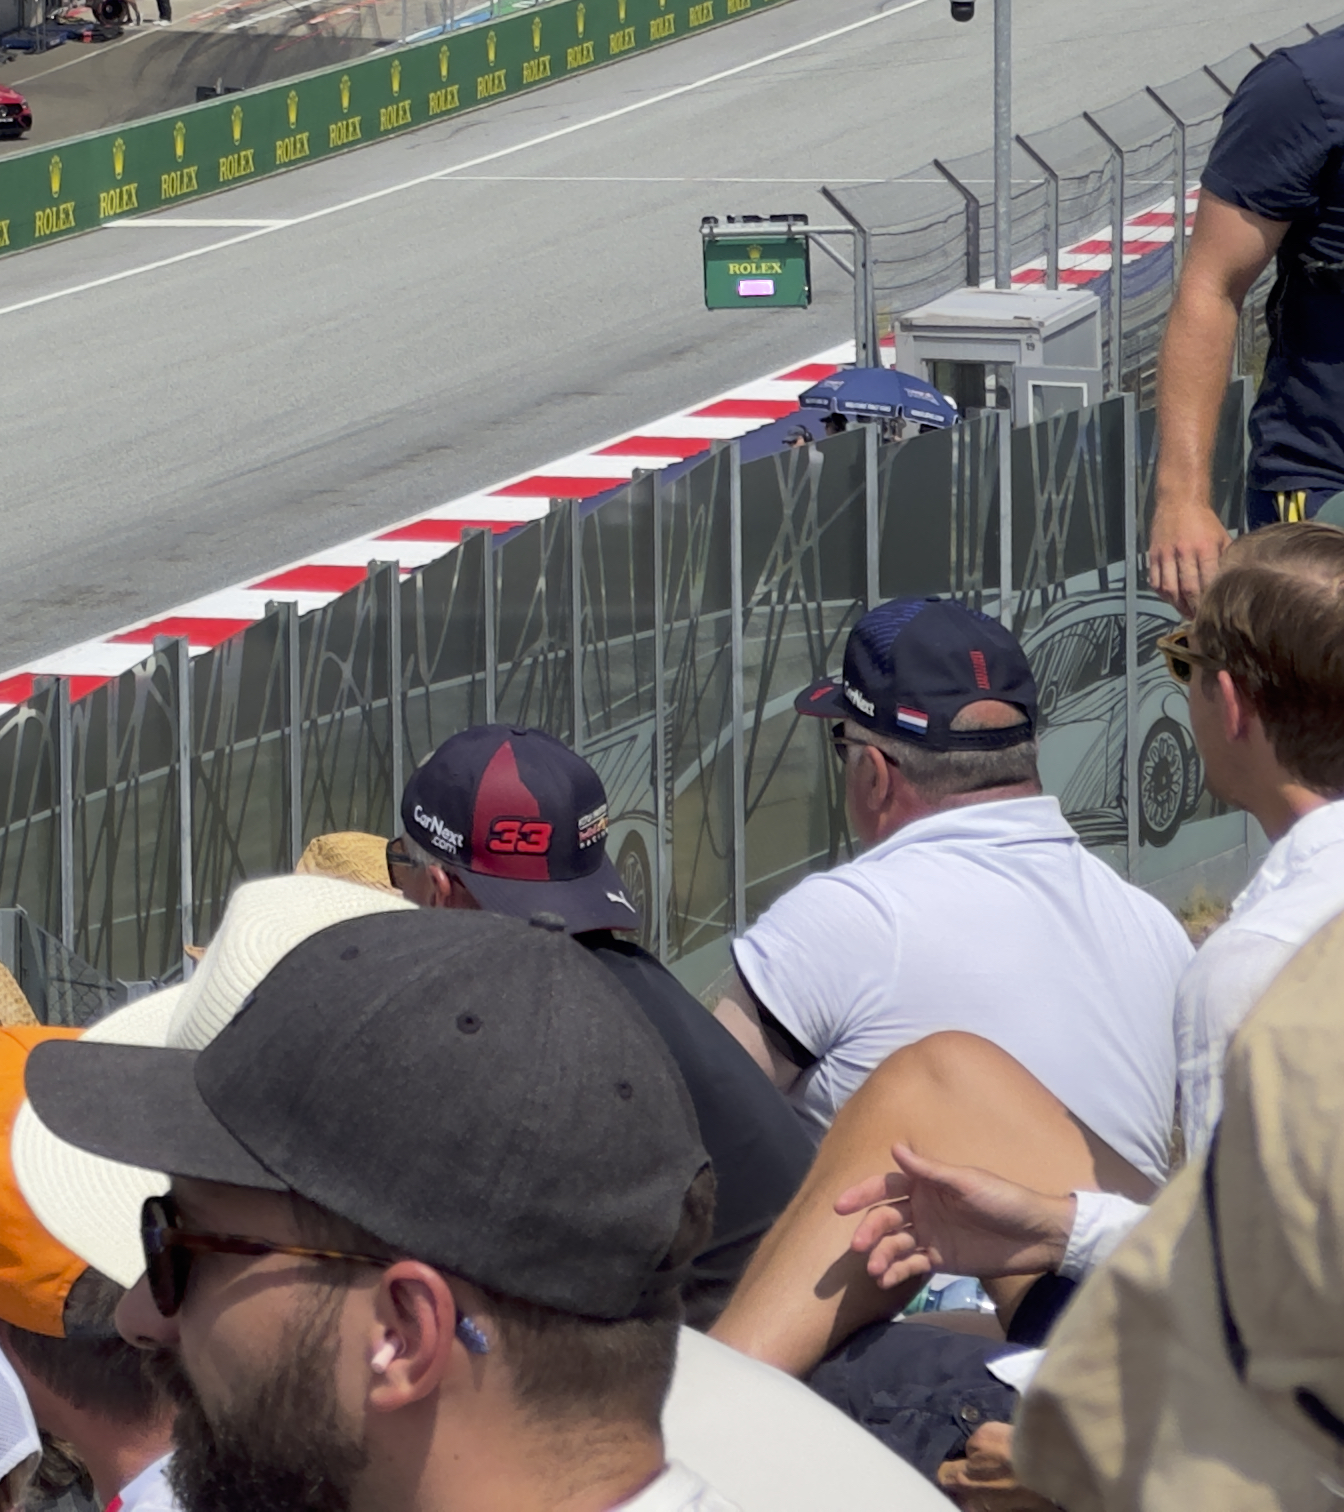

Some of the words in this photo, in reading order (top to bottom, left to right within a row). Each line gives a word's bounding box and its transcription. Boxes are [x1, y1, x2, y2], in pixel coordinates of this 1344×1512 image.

[649, 13, 674, 39] ROLEX
[689, 1, 712, 26] ROLEX
[566, 41, 593, 67] ROLEX
[609, 27, 634, 53] ROLEX
[476, 69, 505, 97] ROLEX
[522, 55, 549, 82] ROLEX
[428, 84, 458, 113] ROLEX
[379, 99, 410, 130] ROLEX
[329, 116, 360, 146] ROLEX
[275, 132, 308, 162] ROLEX
[219, 148, 253, 180] ROLEX
[160, 165, 197, 197] ROLEX
[99, 182, 137, 216] ROLEX
[34, 201, 74, 235] ROLEX
[728, 262, 783, 275] ROLEX
[413, 804, 464, 849] CarNext
[489, 819, 553, 855] 33
[431, 834, 458, 855] .com
